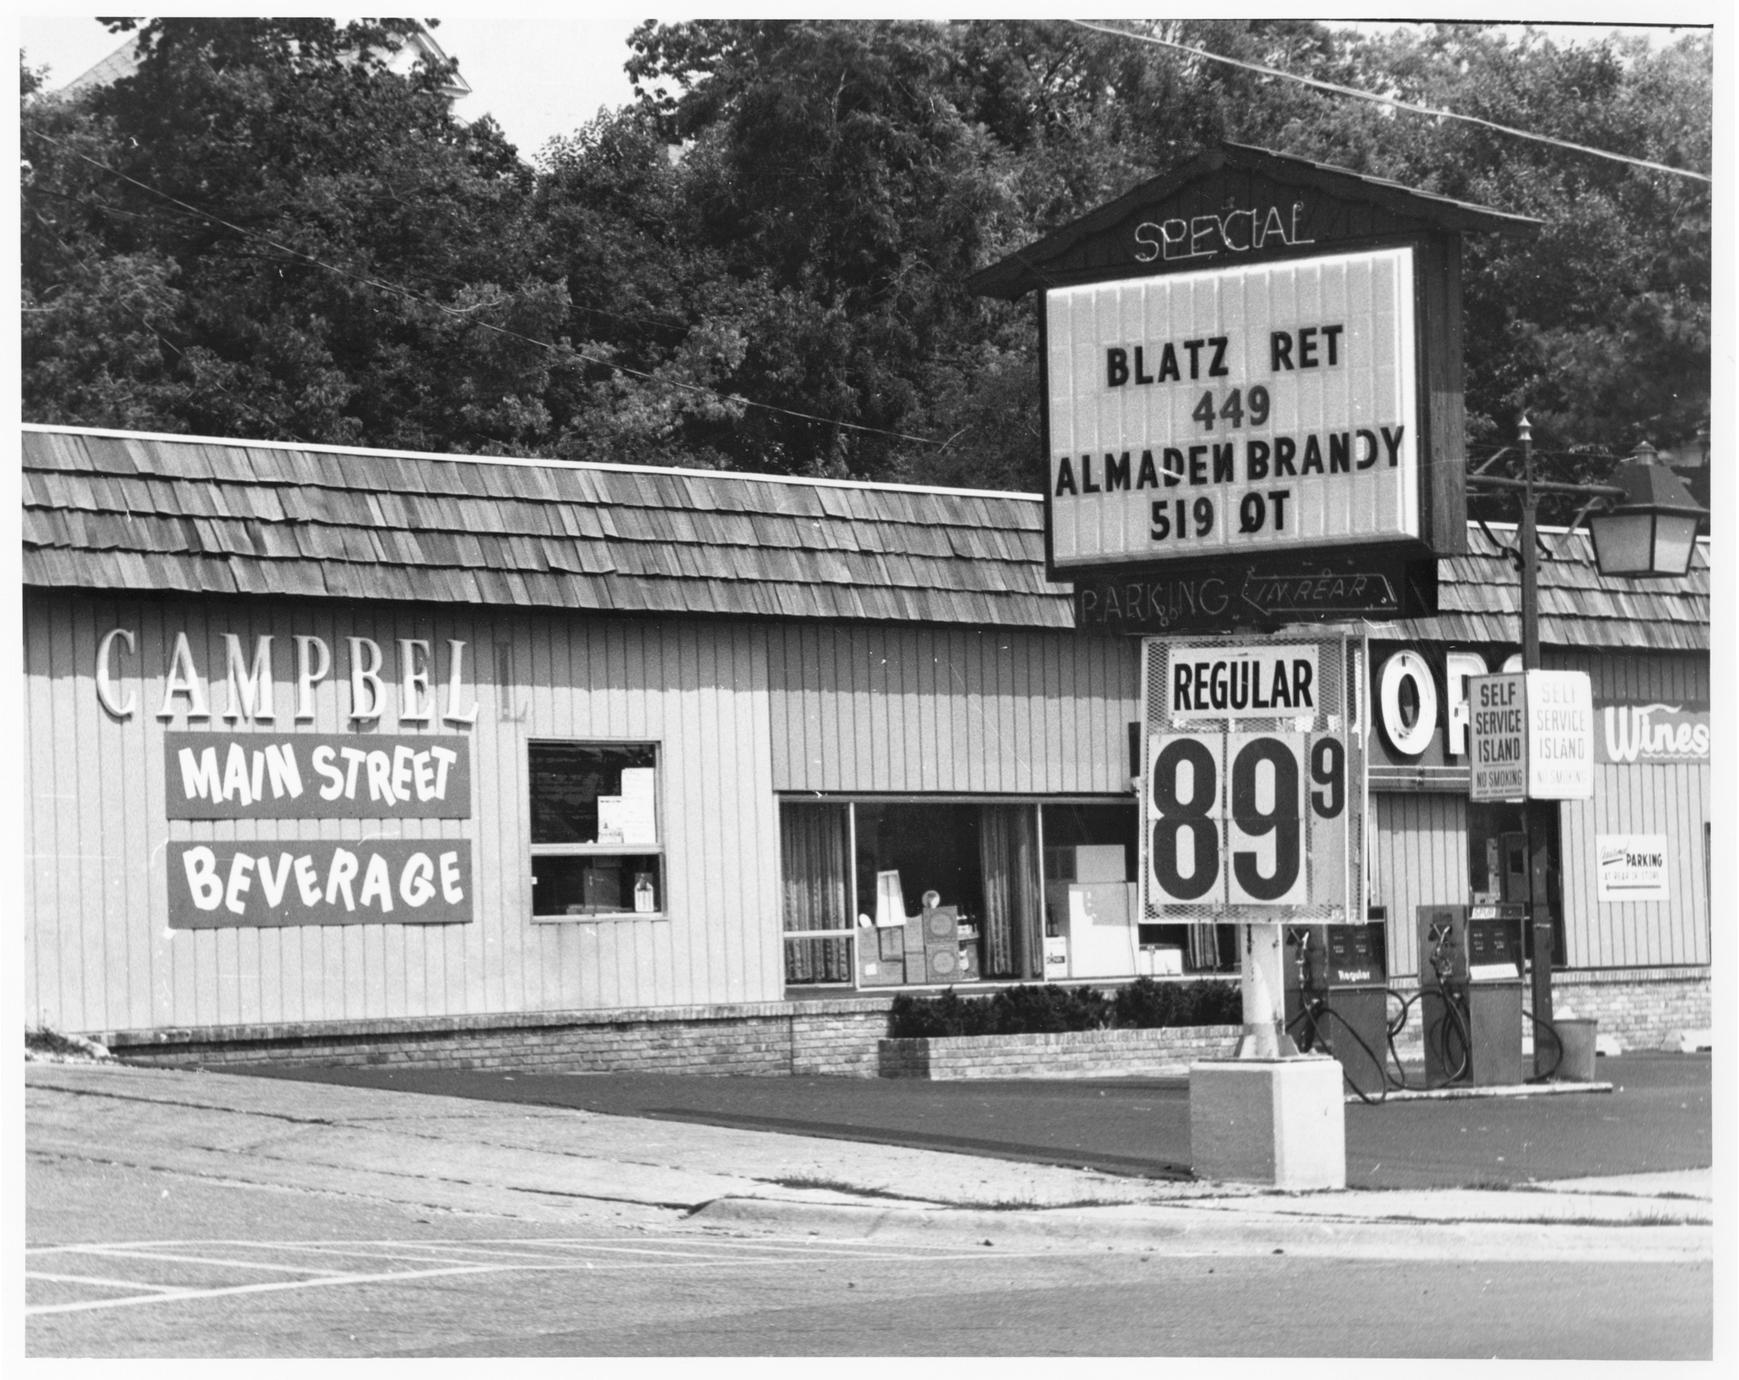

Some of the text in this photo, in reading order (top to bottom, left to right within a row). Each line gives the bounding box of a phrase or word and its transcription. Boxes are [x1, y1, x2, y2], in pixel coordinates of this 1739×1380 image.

[1134, 202, 1315, 262] SPECIAL
[1107, 325, 1344, 388] BLATZ RET
[1192, 385, 1271, 431] 449
[1055, 425, 1405, 497] ALMADEN BRANDY
[1150, 497, 1214, 541] 519
[1081, 575, 1368, 623] PARKING IN REAR
[1173, 658, 1314, 711] REGULAR
[1480, 682, 1516, 708] SELF
[1476, 710, 1522, 735] SERVICE
[1537, 710, 1585, 732] SERVICE
[1604, 703, 1711, 762] Wines
[1478, 737, 1520, 763] ISLAND
[1540, 737, 1585, 760] ISLAND
[178, 742, 457, 807] MAIN STREET
[1477, 769, 1522, 788] NO SMOKING
[182, 846, 464, 915] BEVERAGE
[1626, 852, 1663, 868] PARKING
[1338, 969, 1370, 982] Regular
